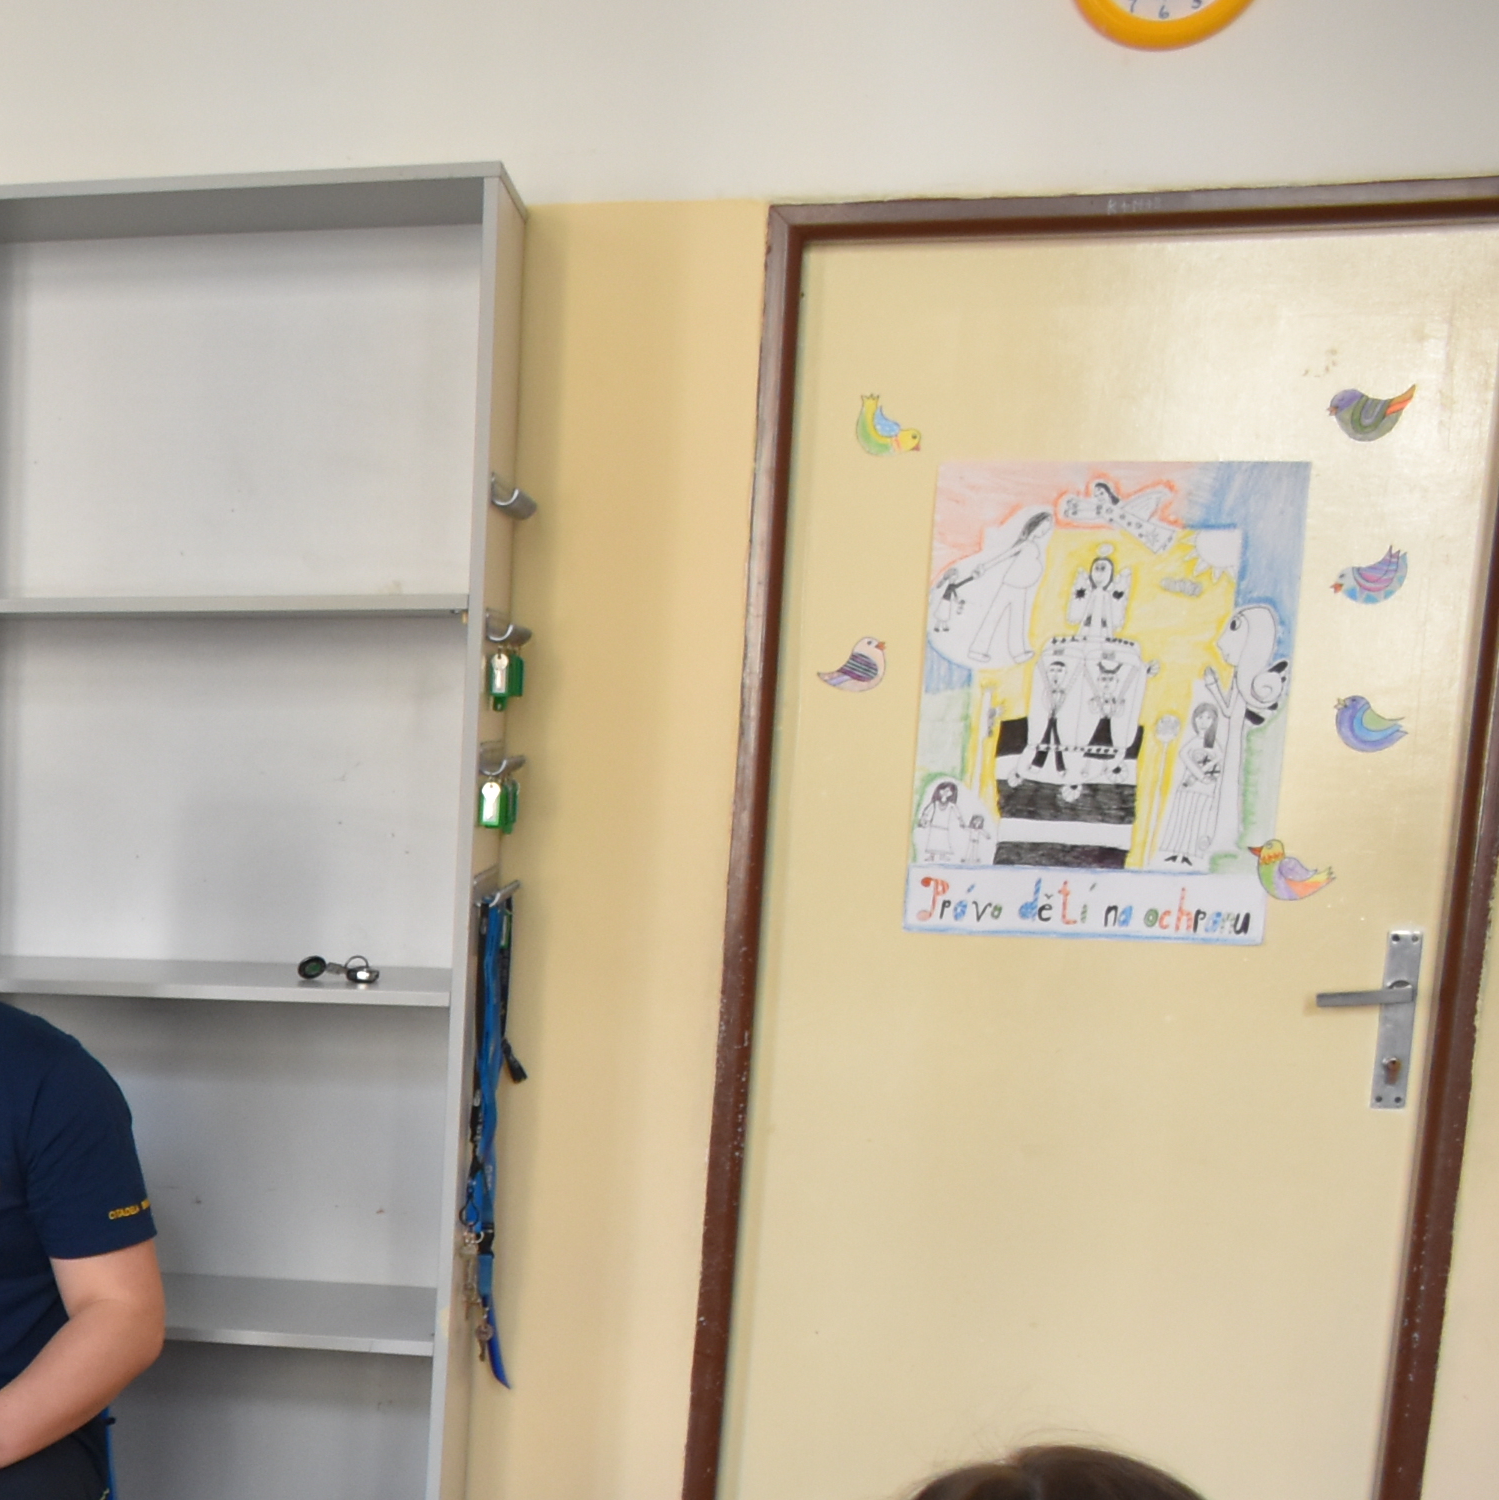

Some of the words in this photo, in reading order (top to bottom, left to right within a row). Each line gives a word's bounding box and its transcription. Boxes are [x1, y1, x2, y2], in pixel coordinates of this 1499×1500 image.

[1159, 5, 1169, 19] 6
[916, 877, 1002, 922] Právo
[1019, 878, 1098, 926] dětí
[1104, 904, 1133, 928] na
